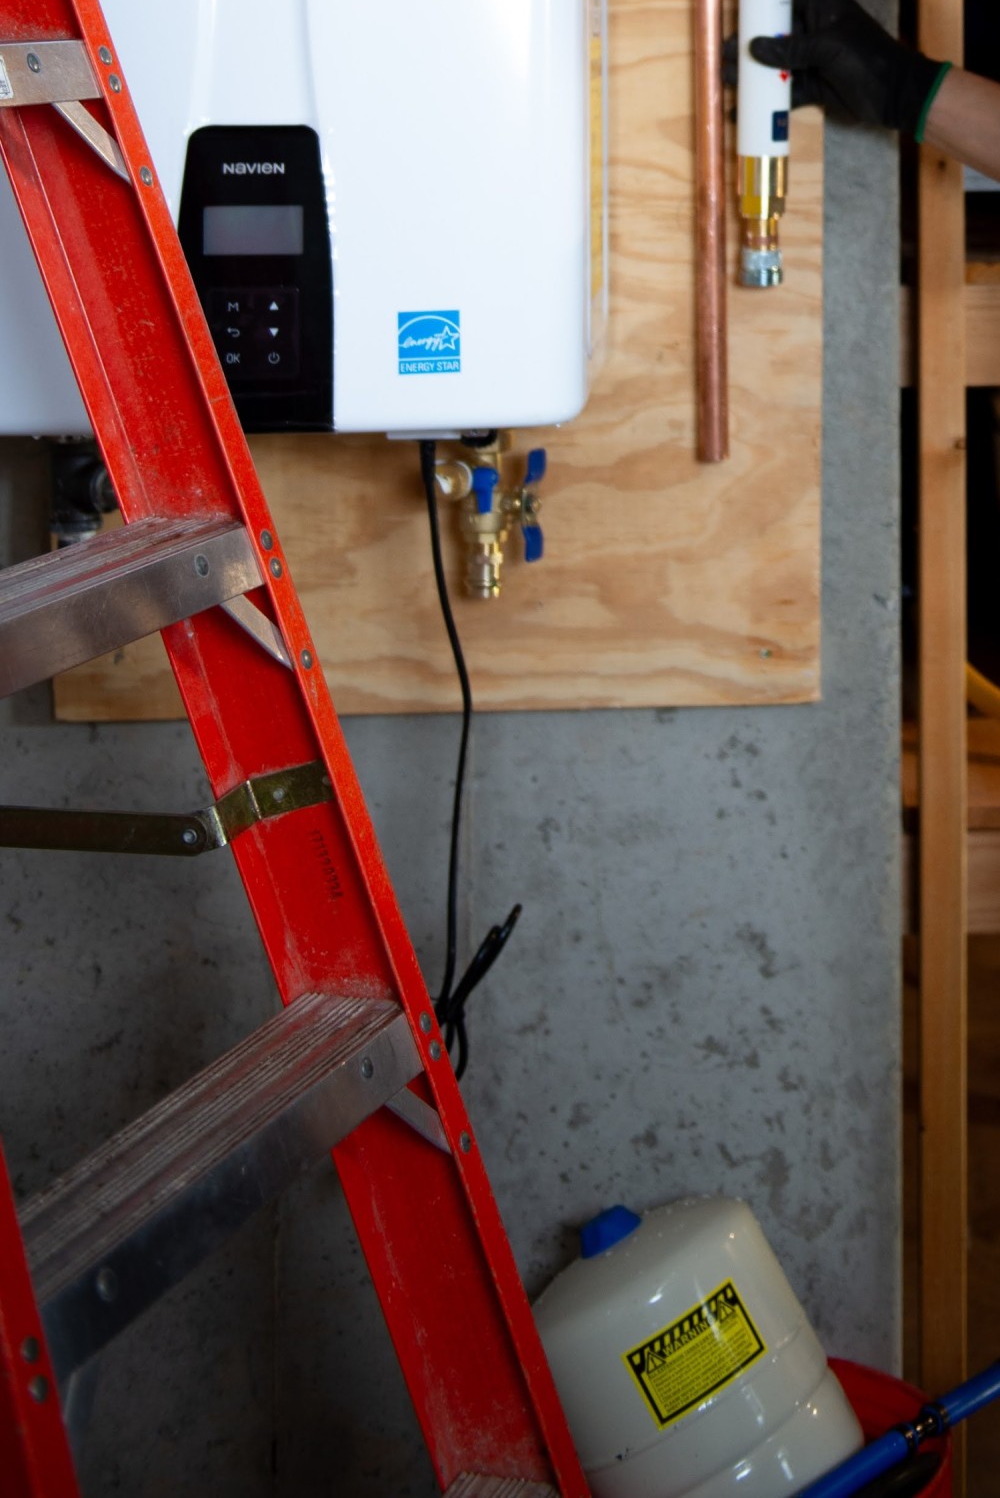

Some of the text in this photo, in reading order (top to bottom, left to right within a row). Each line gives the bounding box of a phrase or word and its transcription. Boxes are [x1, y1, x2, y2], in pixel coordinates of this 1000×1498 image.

[226, 353, 241, 364] OK
[400, 360, 459, 373] ENERGY STAR
